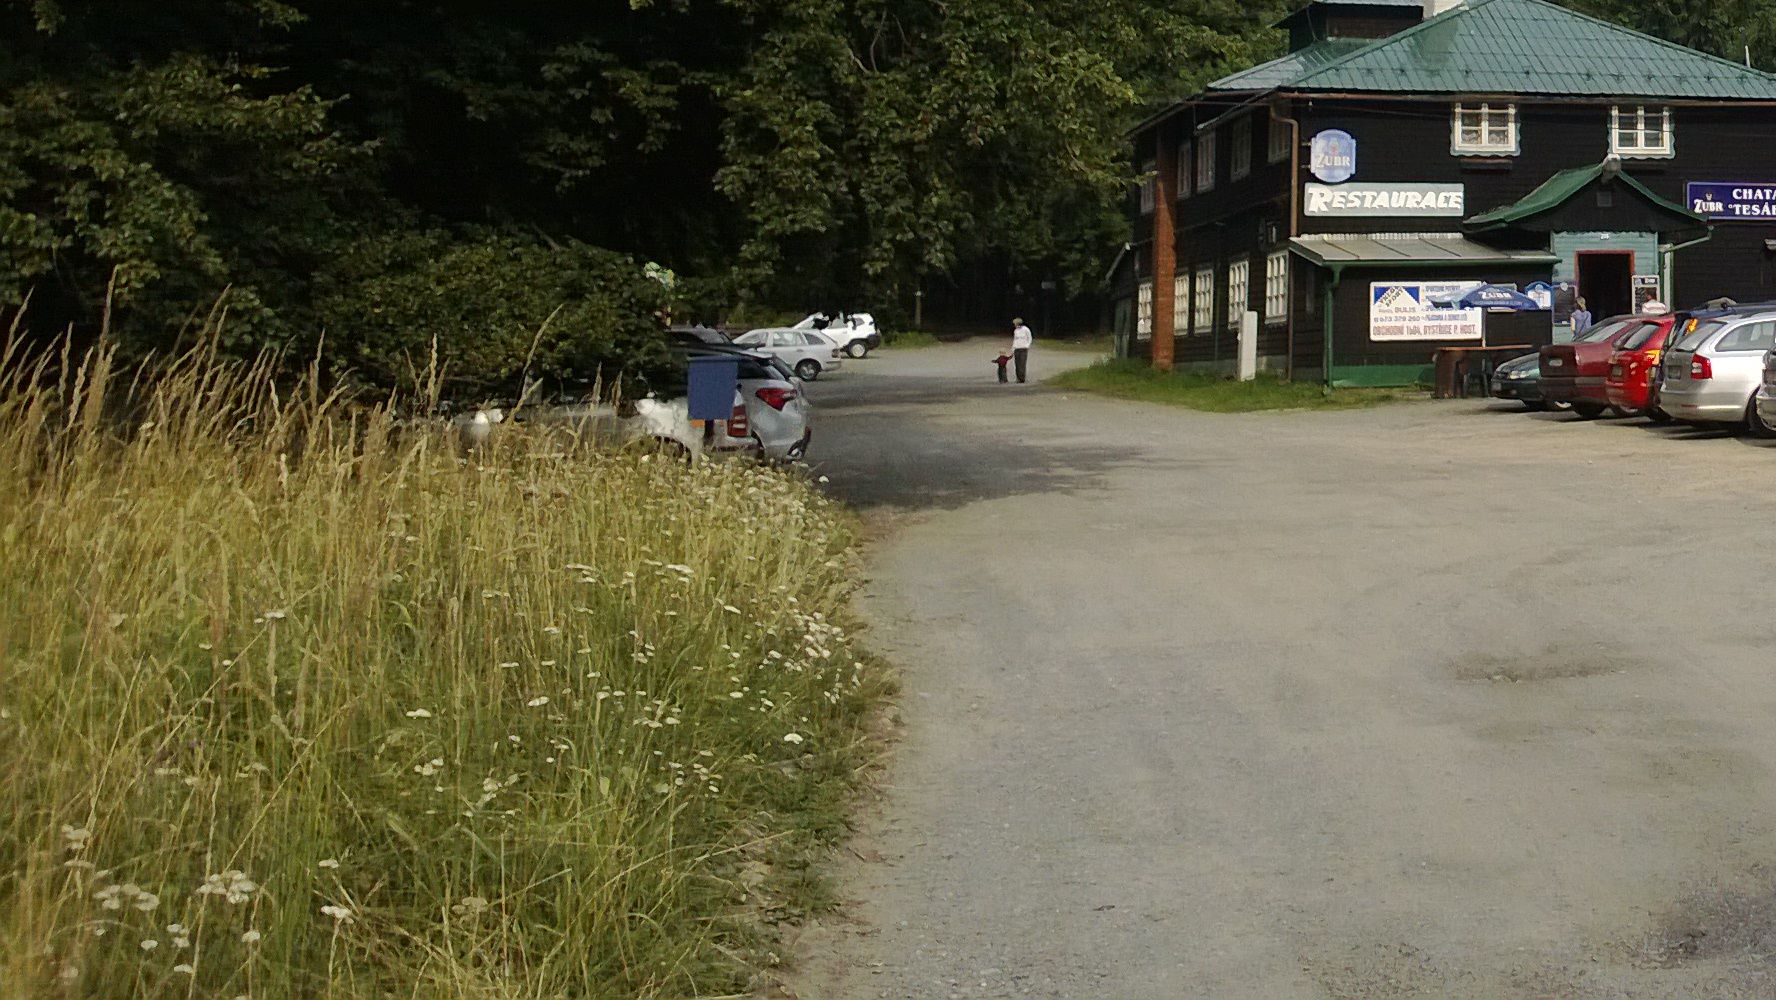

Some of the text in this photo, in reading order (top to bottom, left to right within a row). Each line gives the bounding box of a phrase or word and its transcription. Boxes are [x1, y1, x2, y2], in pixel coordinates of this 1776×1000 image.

[1315, 153, 1350, 168] ZUBR
[1308, 187, 1463, 213] RESTAURACE
[1693, 199, 1724, 213] ZUBR
